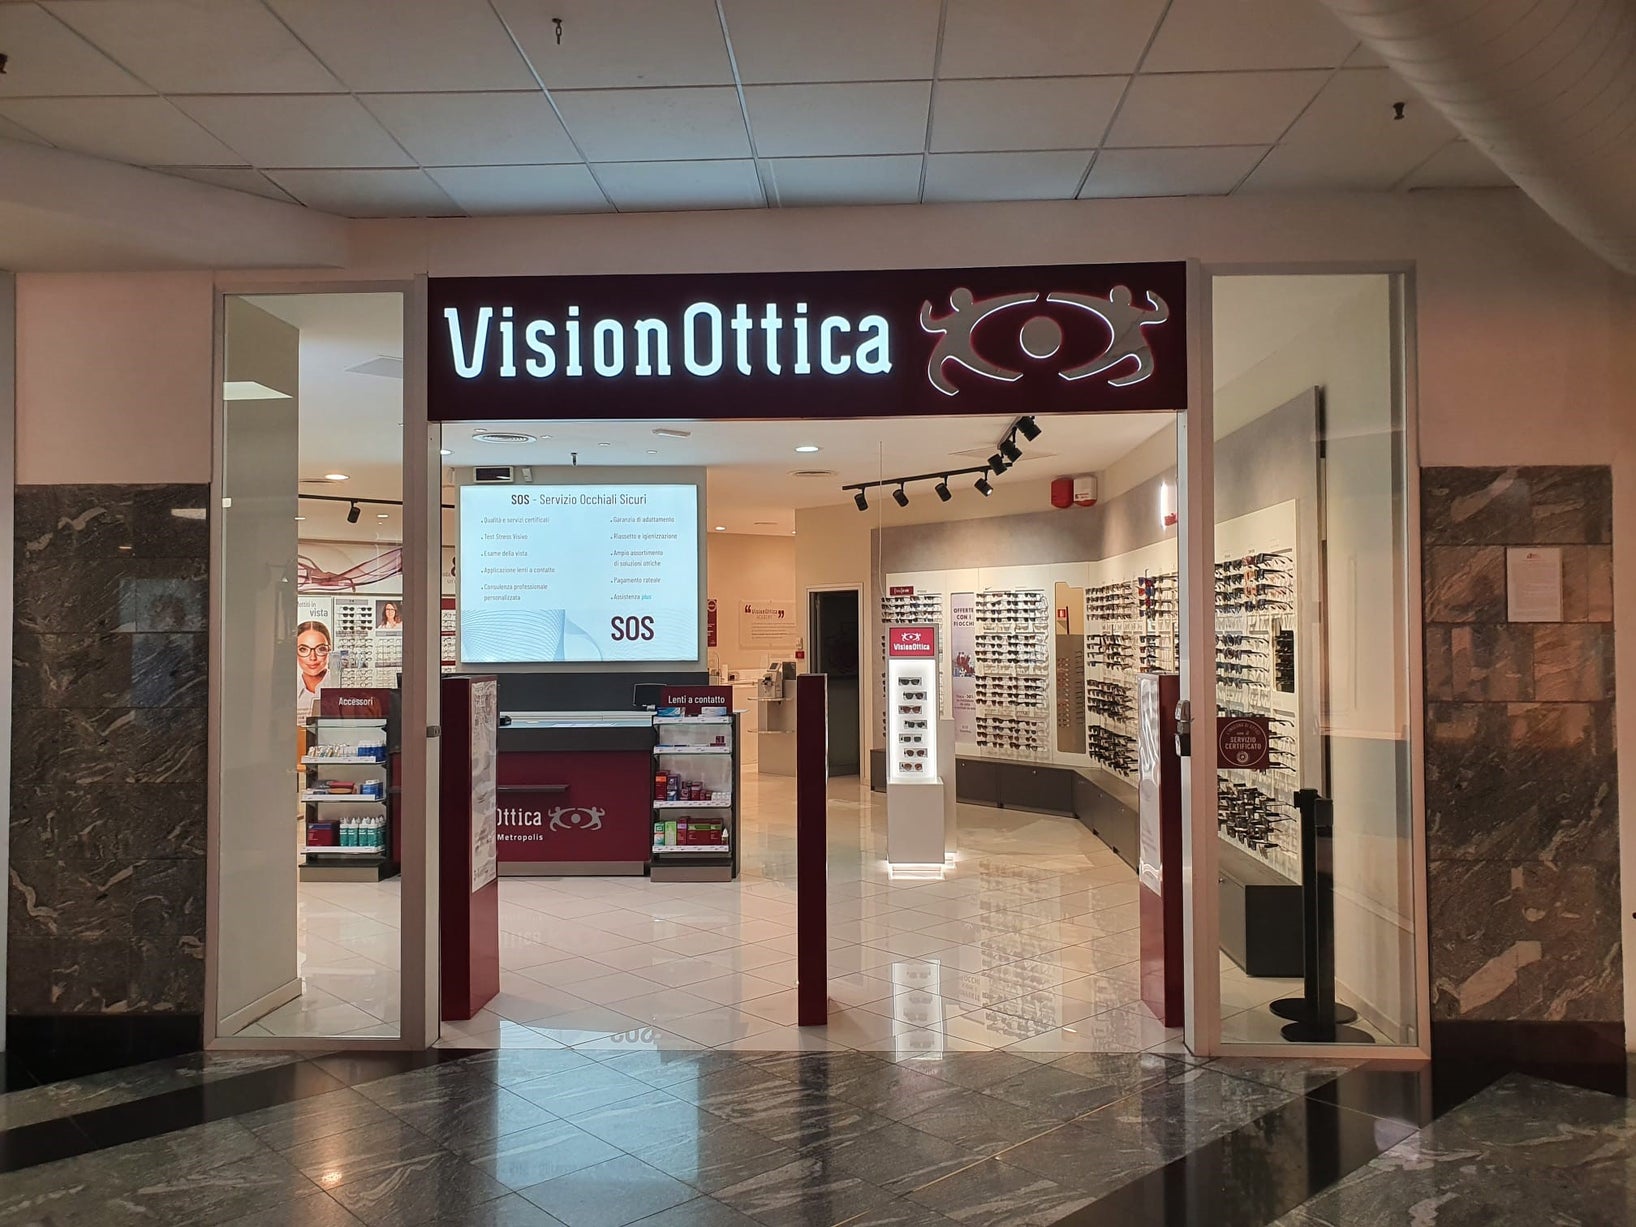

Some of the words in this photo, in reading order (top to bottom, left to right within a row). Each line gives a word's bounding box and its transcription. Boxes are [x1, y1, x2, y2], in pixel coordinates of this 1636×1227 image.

[444, 302, 893, 379] VisionOttica
[511, 494, 530, 505] SOS
[539, 493, 577, 505] Servizio
[580, 493, 617, 505] Occhiali
[619, 493, 647, 505] Sicuri
[642, 533, 678, 541] igienizzazione
[613, 577, 642, 585] Pagamento
[483, 594, 521, 602] personalizzata
[309, 608, 329, 617] vista
[611, 616, 655, 641] SOS
[893, 643, 930, 651] VisionOttica
[338, 696, 374, 706] Accessori
[668, 695, 687, 704] Lenti
[694, 695, 725, 704] contatto
[497, 833, 543, 842] Metropolis
